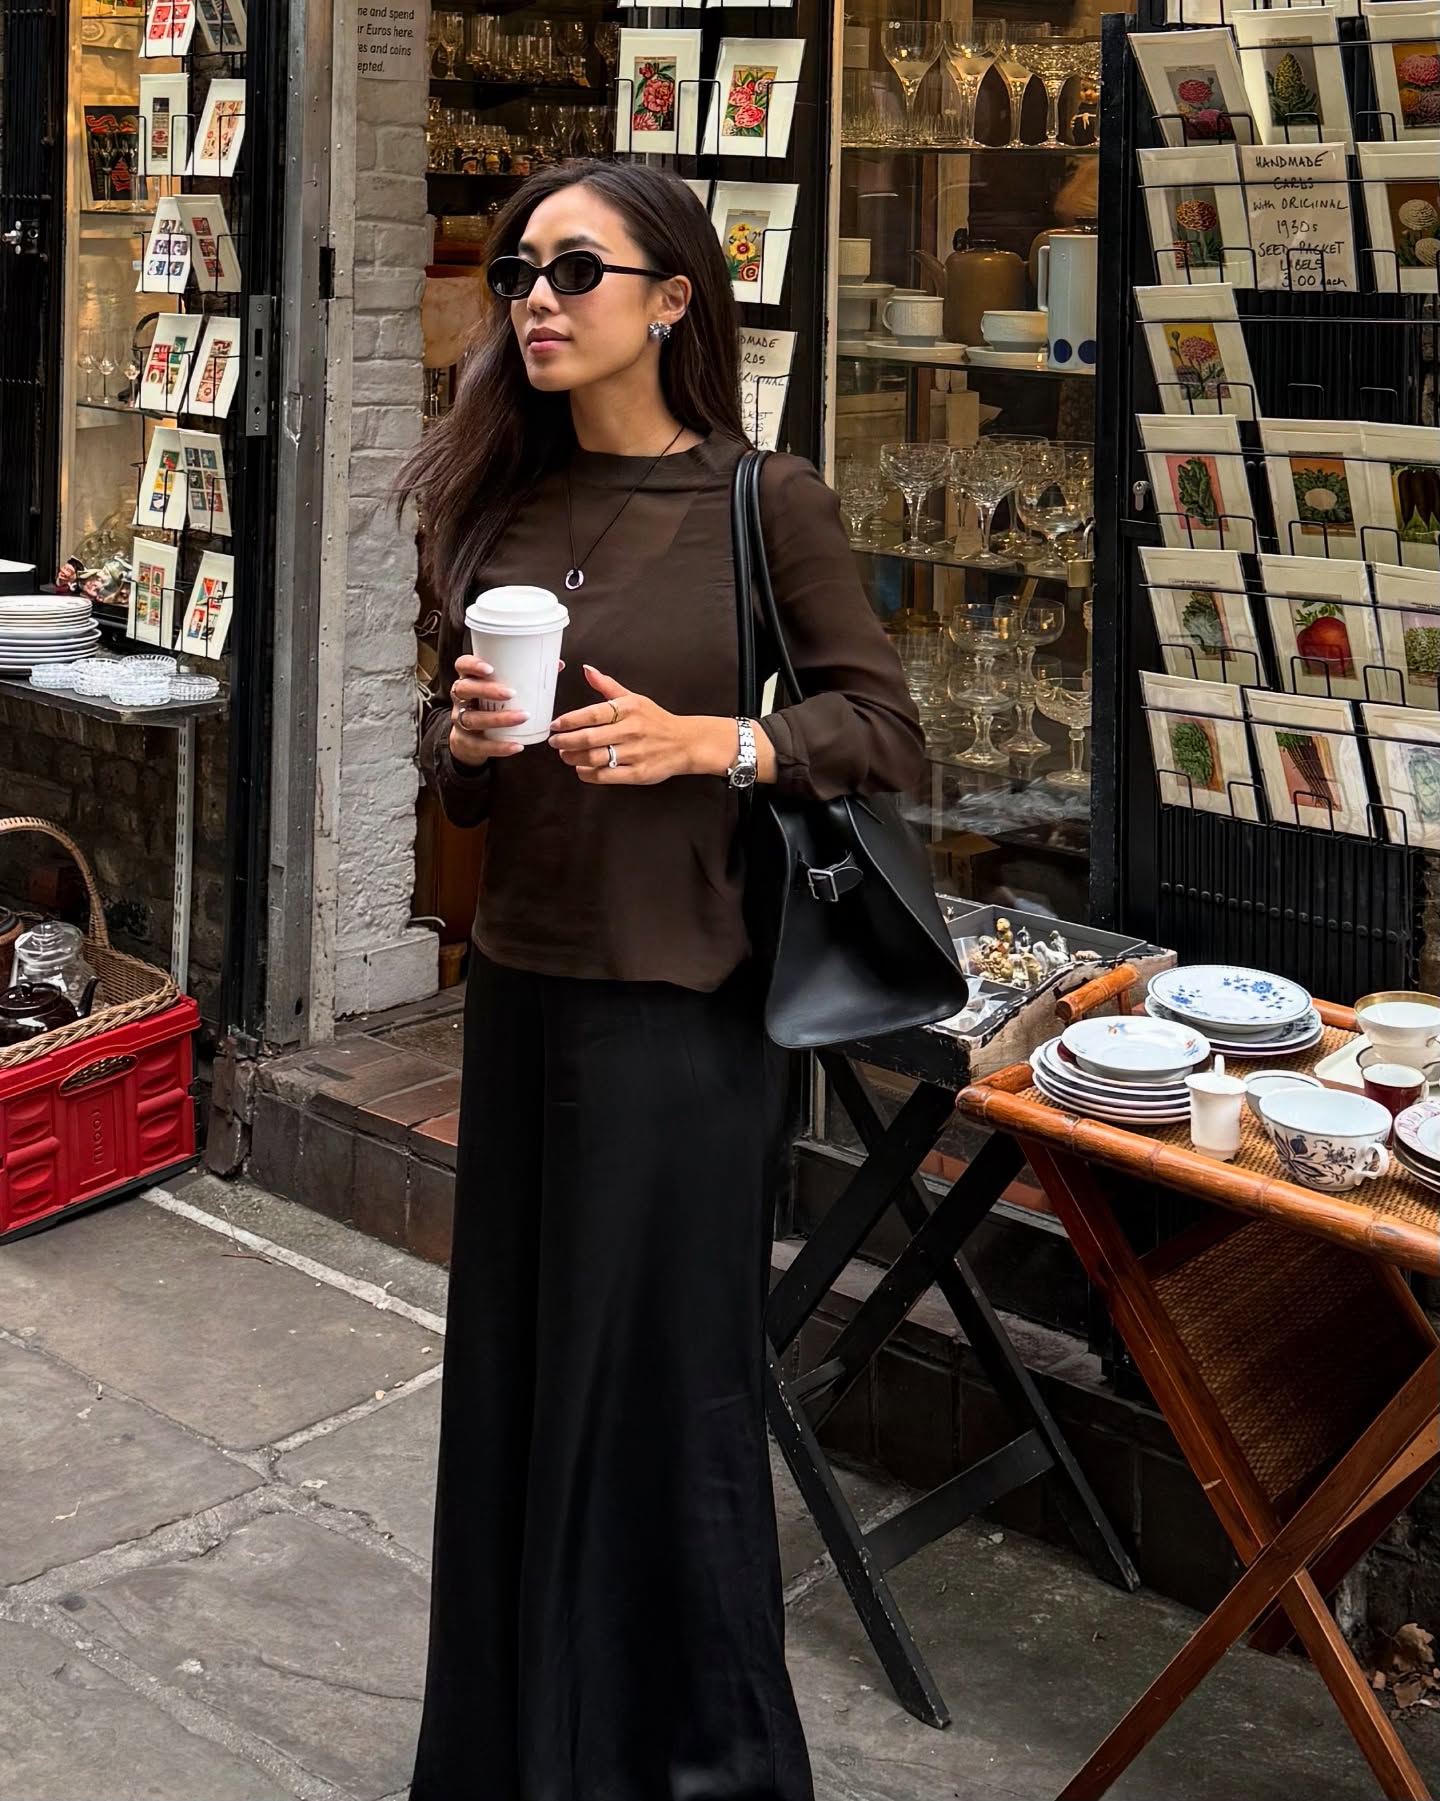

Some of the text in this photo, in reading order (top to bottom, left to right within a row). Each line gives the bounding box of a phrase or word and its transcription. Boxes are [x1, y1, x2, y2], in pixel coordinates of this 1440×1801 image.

[370, 7, 387, 18] and
[389, 9, 414, 21] spend
[366, 24, 391, 36] Euros
[370, 43, 388, 54] and
[390, 45, 411, 56] coins
[357, 61, 384, 74] epted.
[1255, 151, 1329, 169] HANDMADE
[1281, 196, 1348, 210] ORIGINAL
[1276, 219, 1319, 239] 1930s
[737, 335, 780, 349] DMADE
[743, 352, 766, 365] RDS
